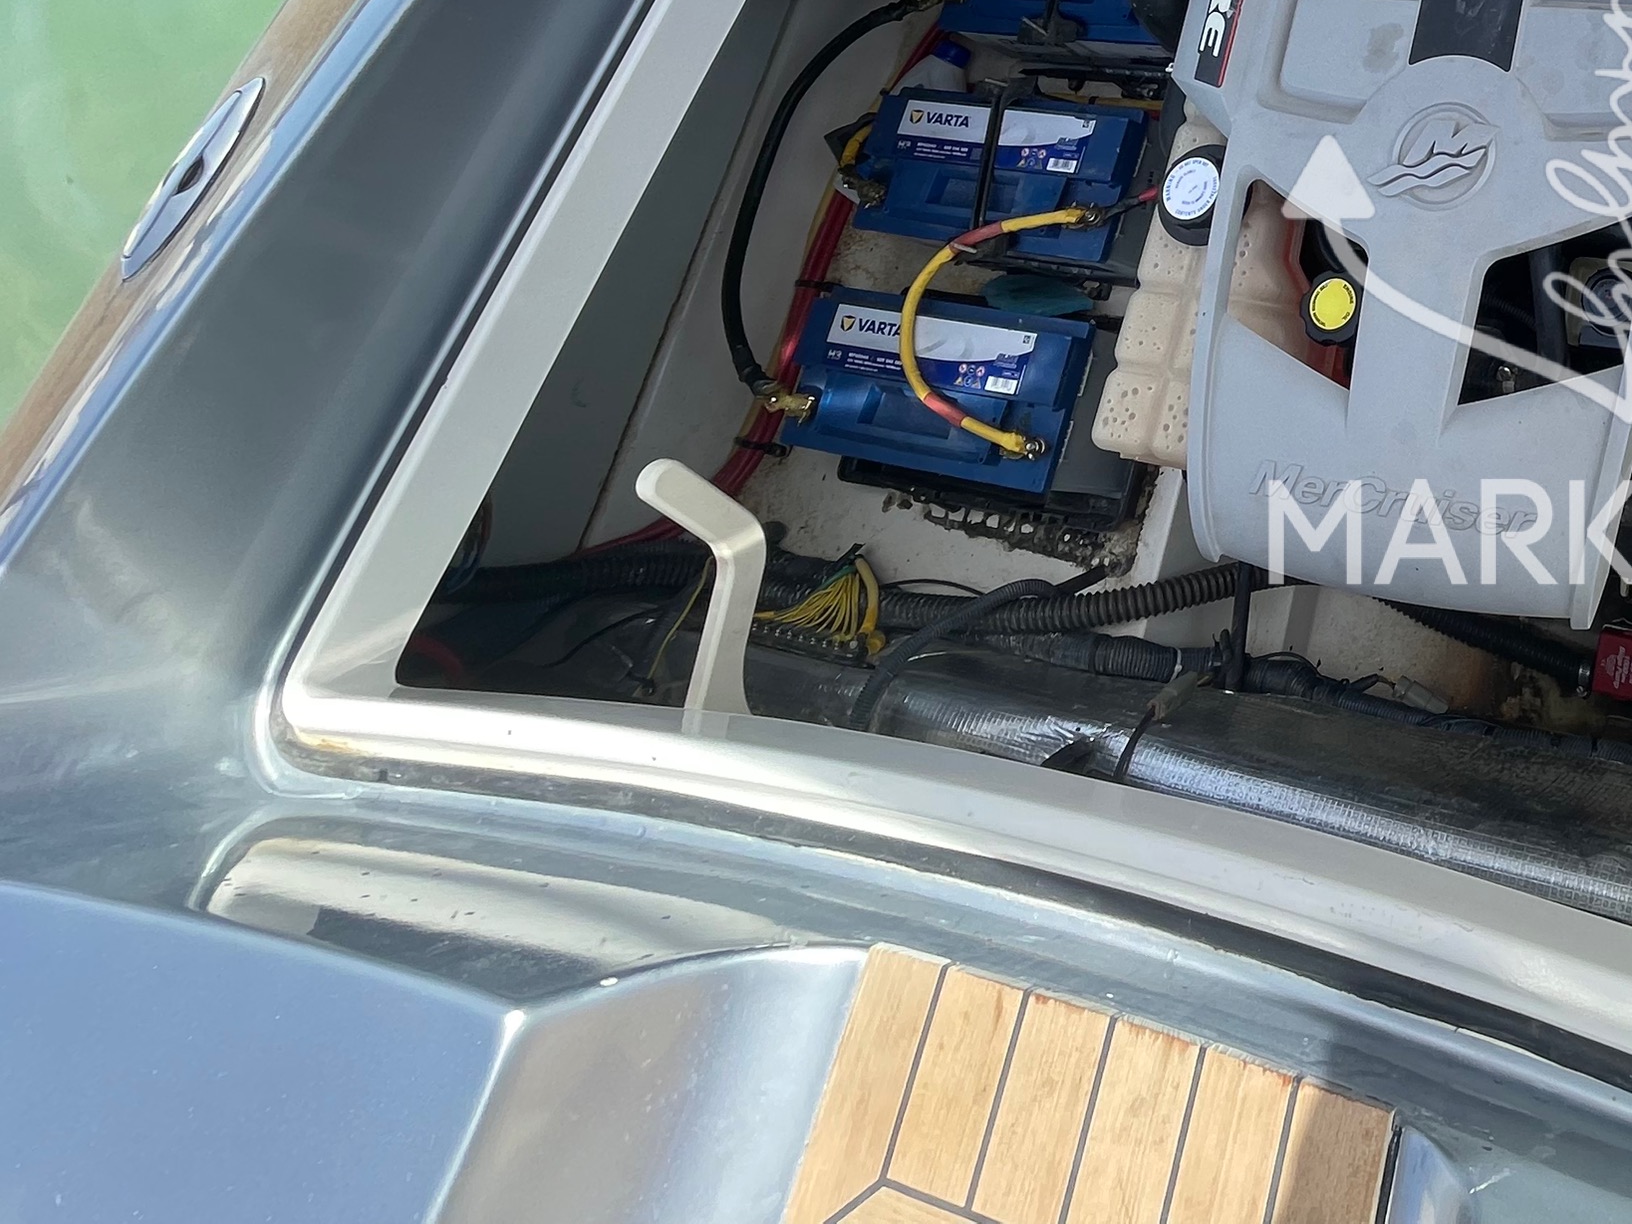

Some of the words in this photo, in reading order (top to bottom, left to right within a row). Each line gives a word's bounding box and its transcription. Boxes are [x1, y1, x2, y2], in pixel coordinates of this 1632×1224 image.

[926, 112, 970, 128] VARTA
[858, 317, 902, 336] VARTA
[1249, 459, 1539, 539] MerCruiser
